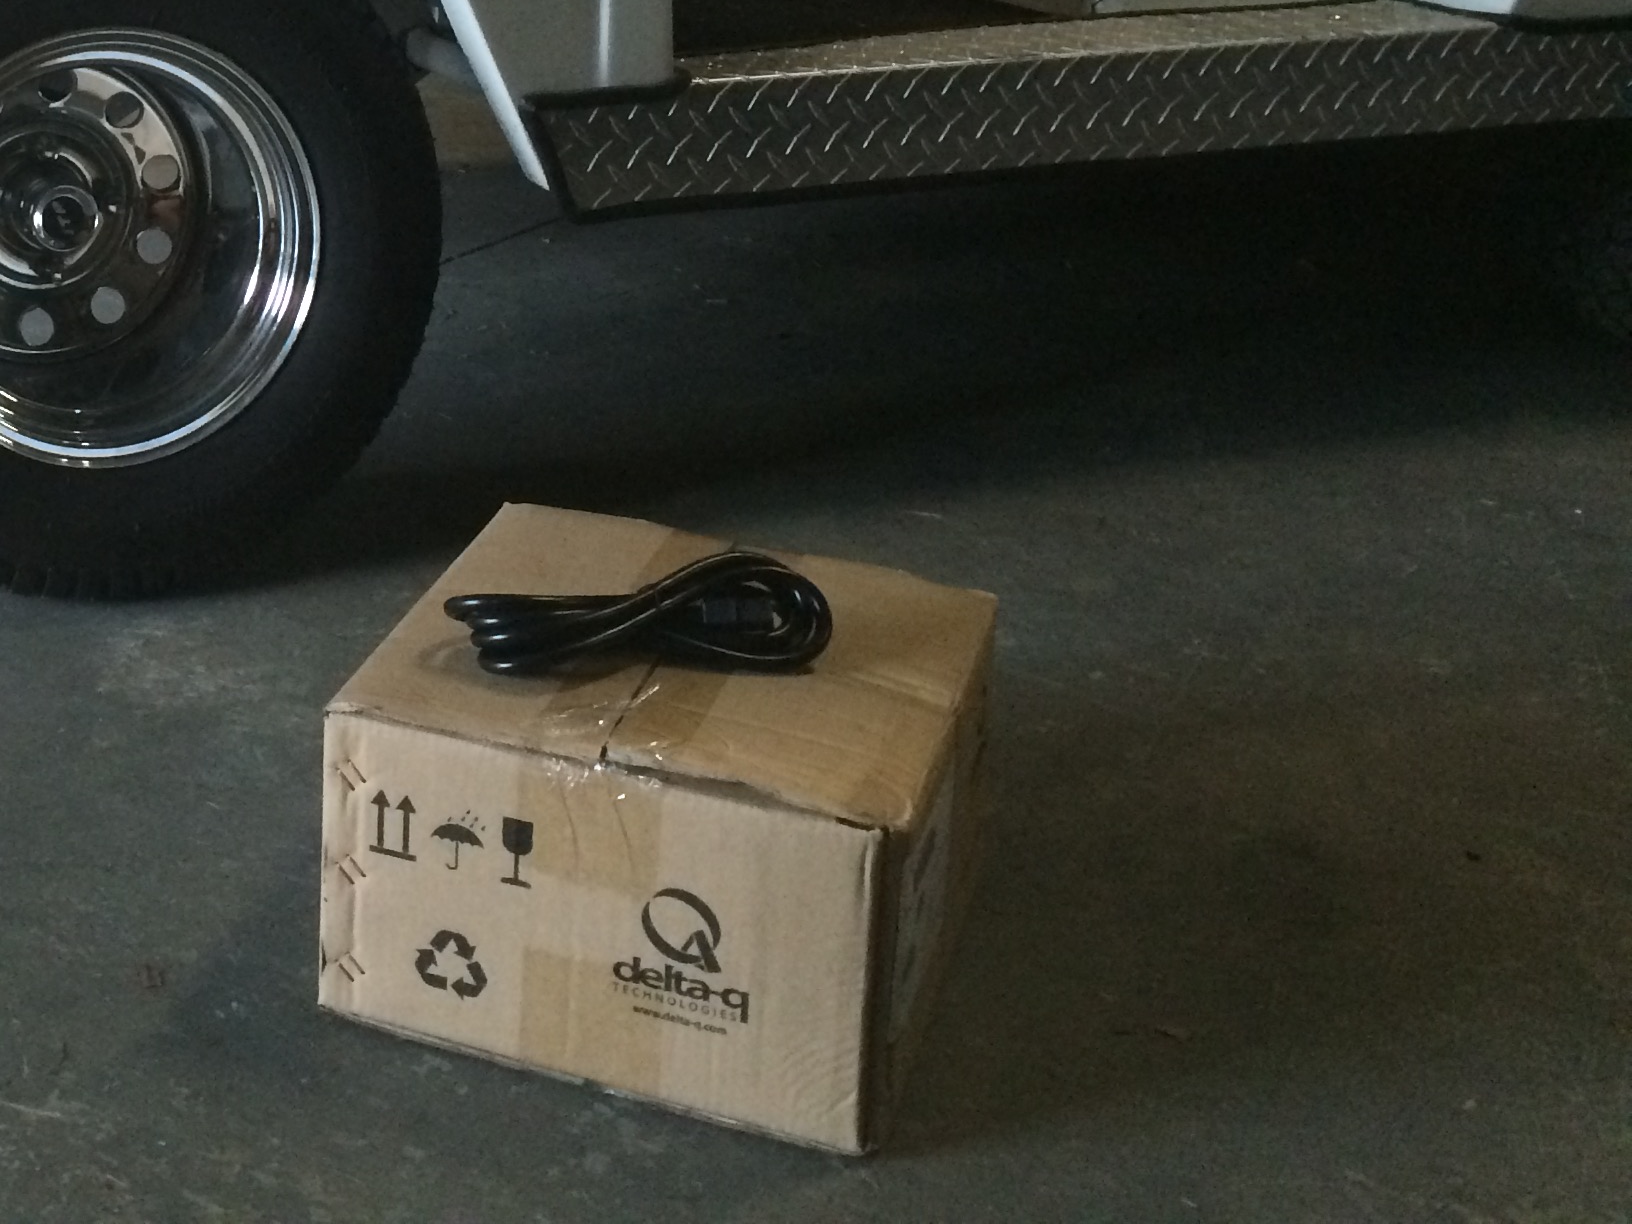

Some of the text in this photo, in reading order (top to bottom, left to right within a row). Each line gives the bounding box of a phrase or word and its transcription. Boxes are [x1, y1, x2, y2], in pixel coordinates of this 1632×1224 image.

[611, 981, 738, 1022] TECHNOLOGIES
[612, 956, 750, 1024] delta-q
[632, 1005, 728, 1036] www.delta-q.com
